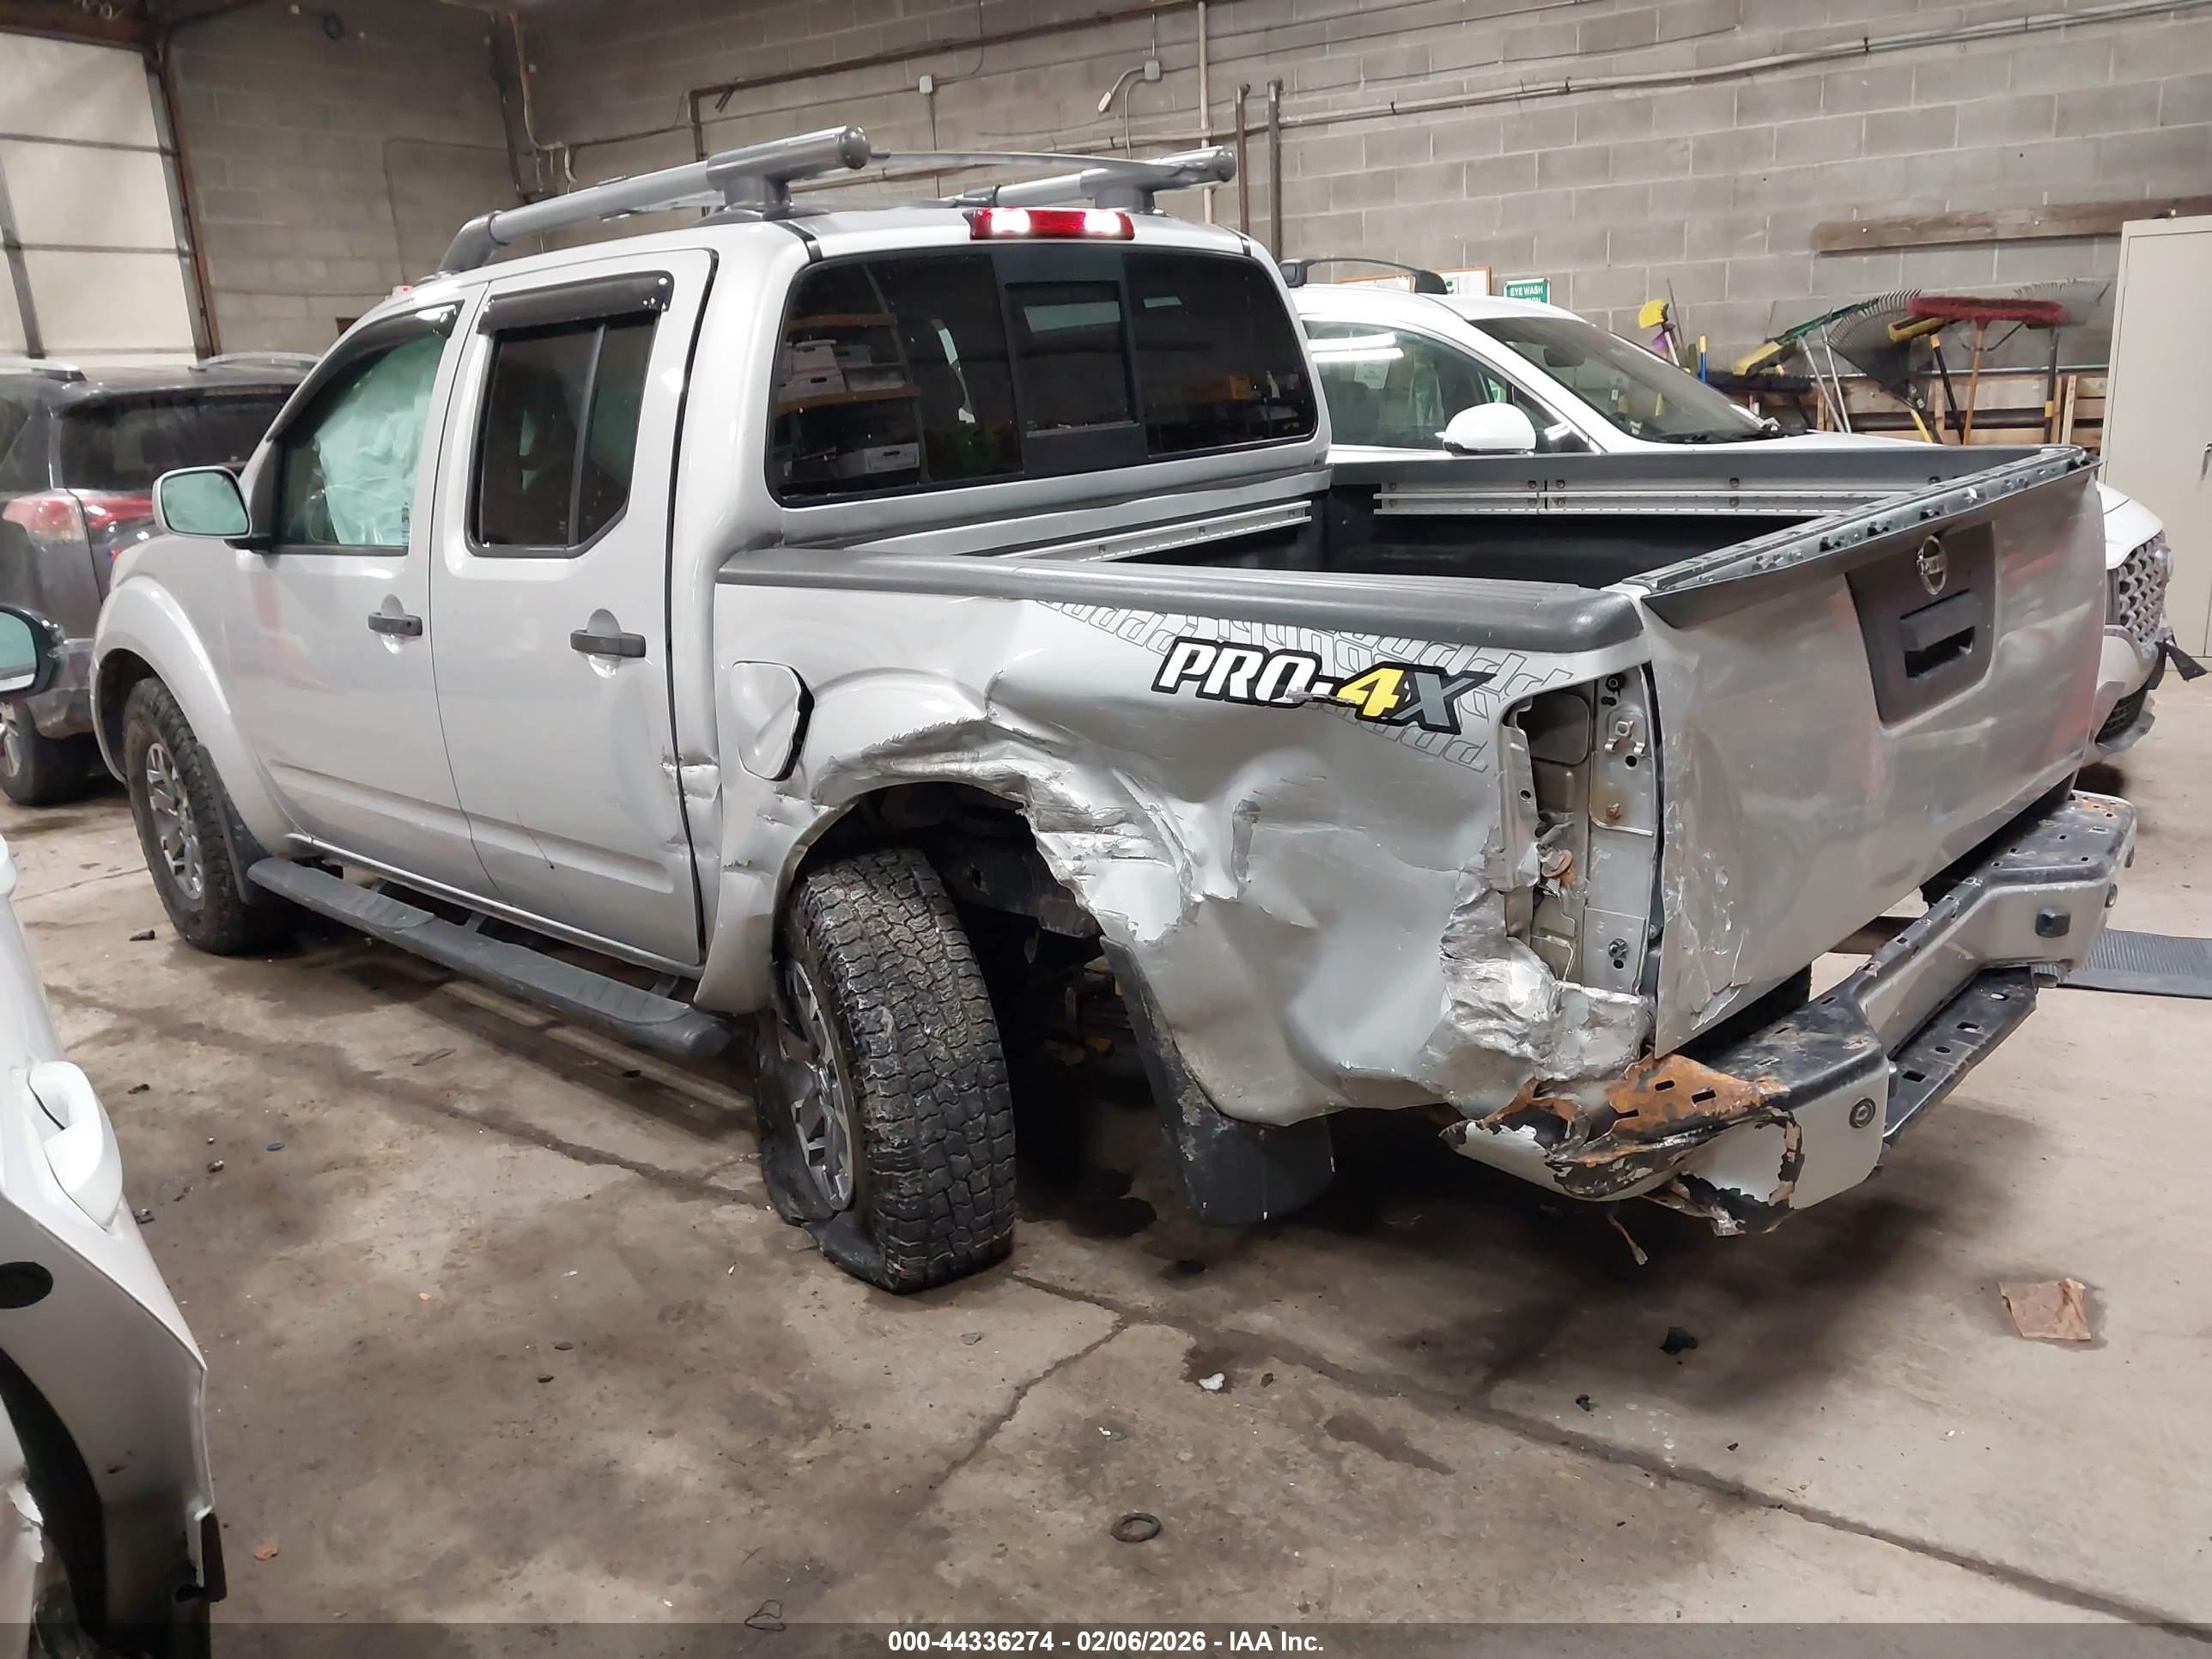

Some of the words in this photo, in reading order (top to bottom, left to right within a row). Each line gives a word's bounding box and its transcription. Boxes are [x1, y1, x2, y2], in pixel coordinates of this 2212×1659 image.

[1510, 287, 1523, 296] EYE
[1524, 285, 1543, 295] WASH
[1152, 637, 1496, 735] PRO-4X
